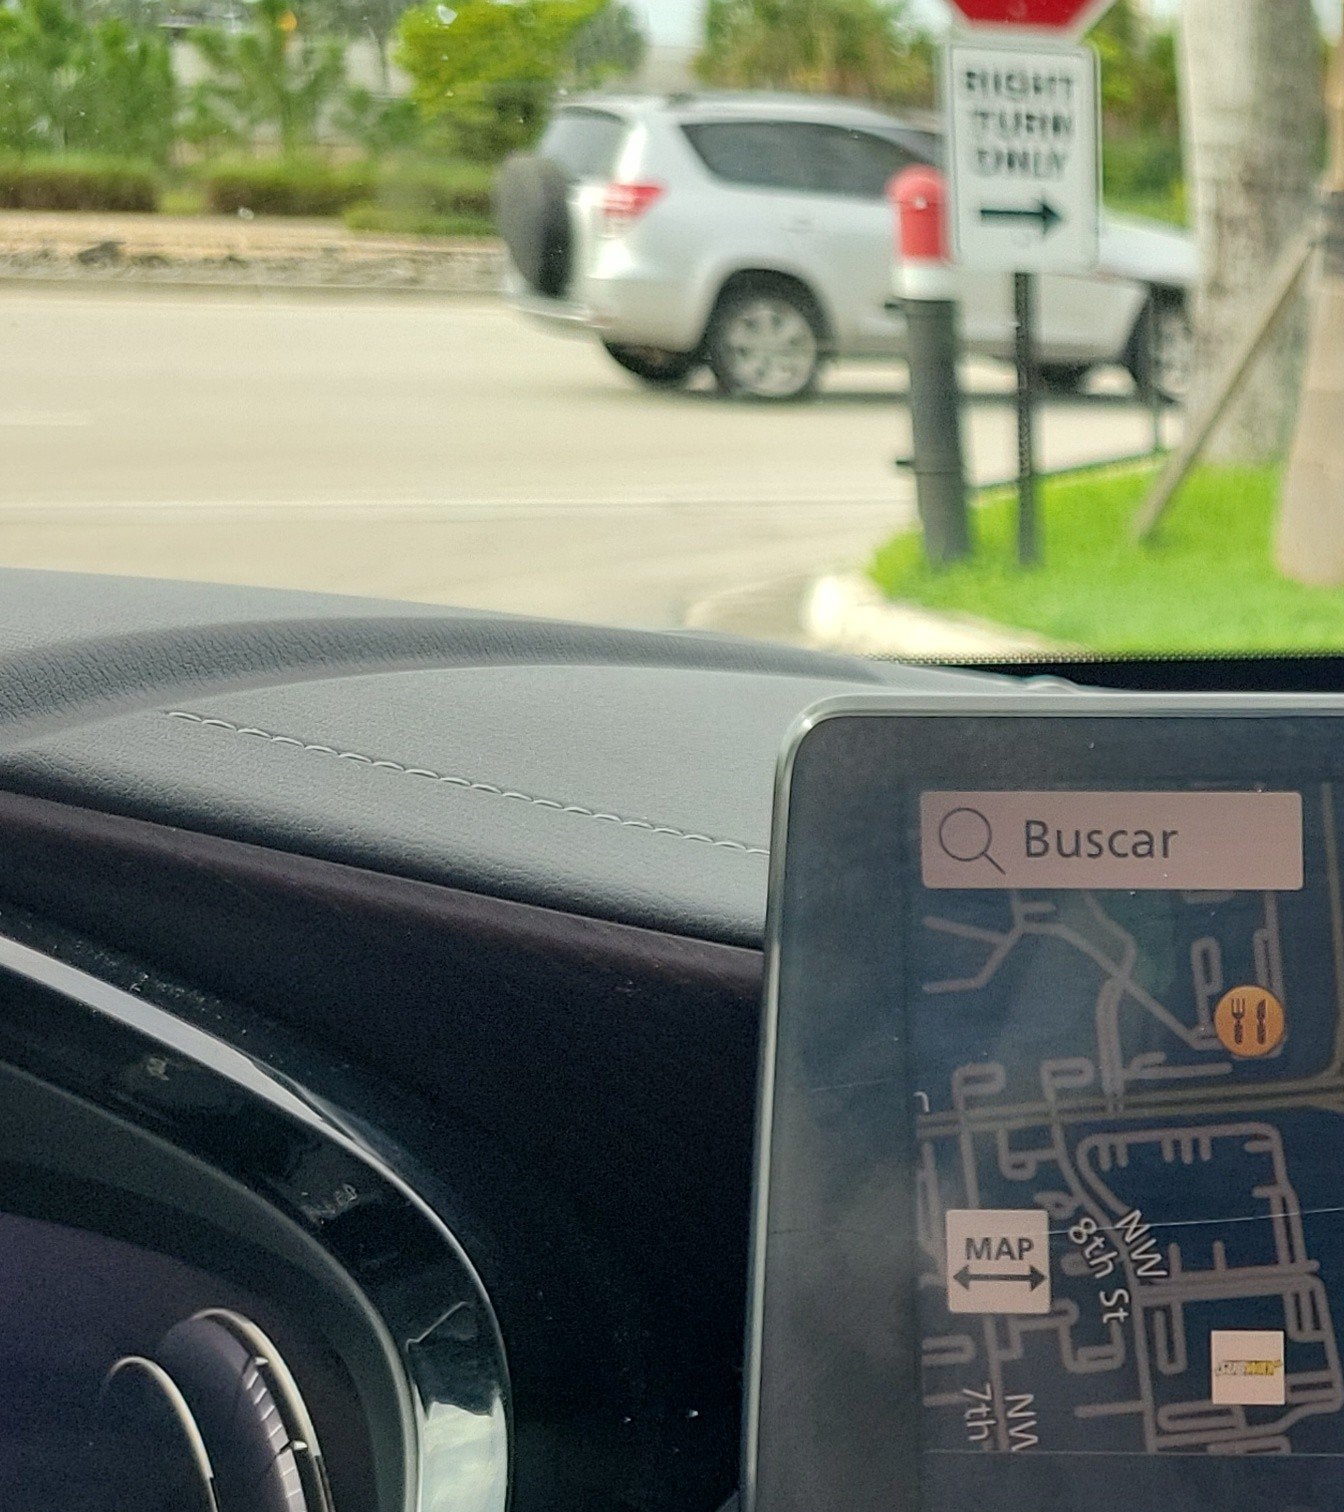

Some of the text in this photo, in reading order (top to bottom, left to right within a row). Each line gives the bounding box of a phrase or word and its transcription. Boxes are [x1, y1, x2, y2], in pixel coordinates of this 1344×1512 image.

[964, 69, 1074, 95] RIGHT
[971, 109, 1074, 136] TURN
[976, 148, 1066, 176] ONLY
[1024, 821, 1178, 860] Buscar
[965, 1237, 1034, 1261] MAP
[1113, 1210, 1168, 1278] NW
[1067, 1217, 1131, 1324] 8th St
[962, 1383, 997, 1441] 7th
[1005, 1393, 1038, 1451] NW
